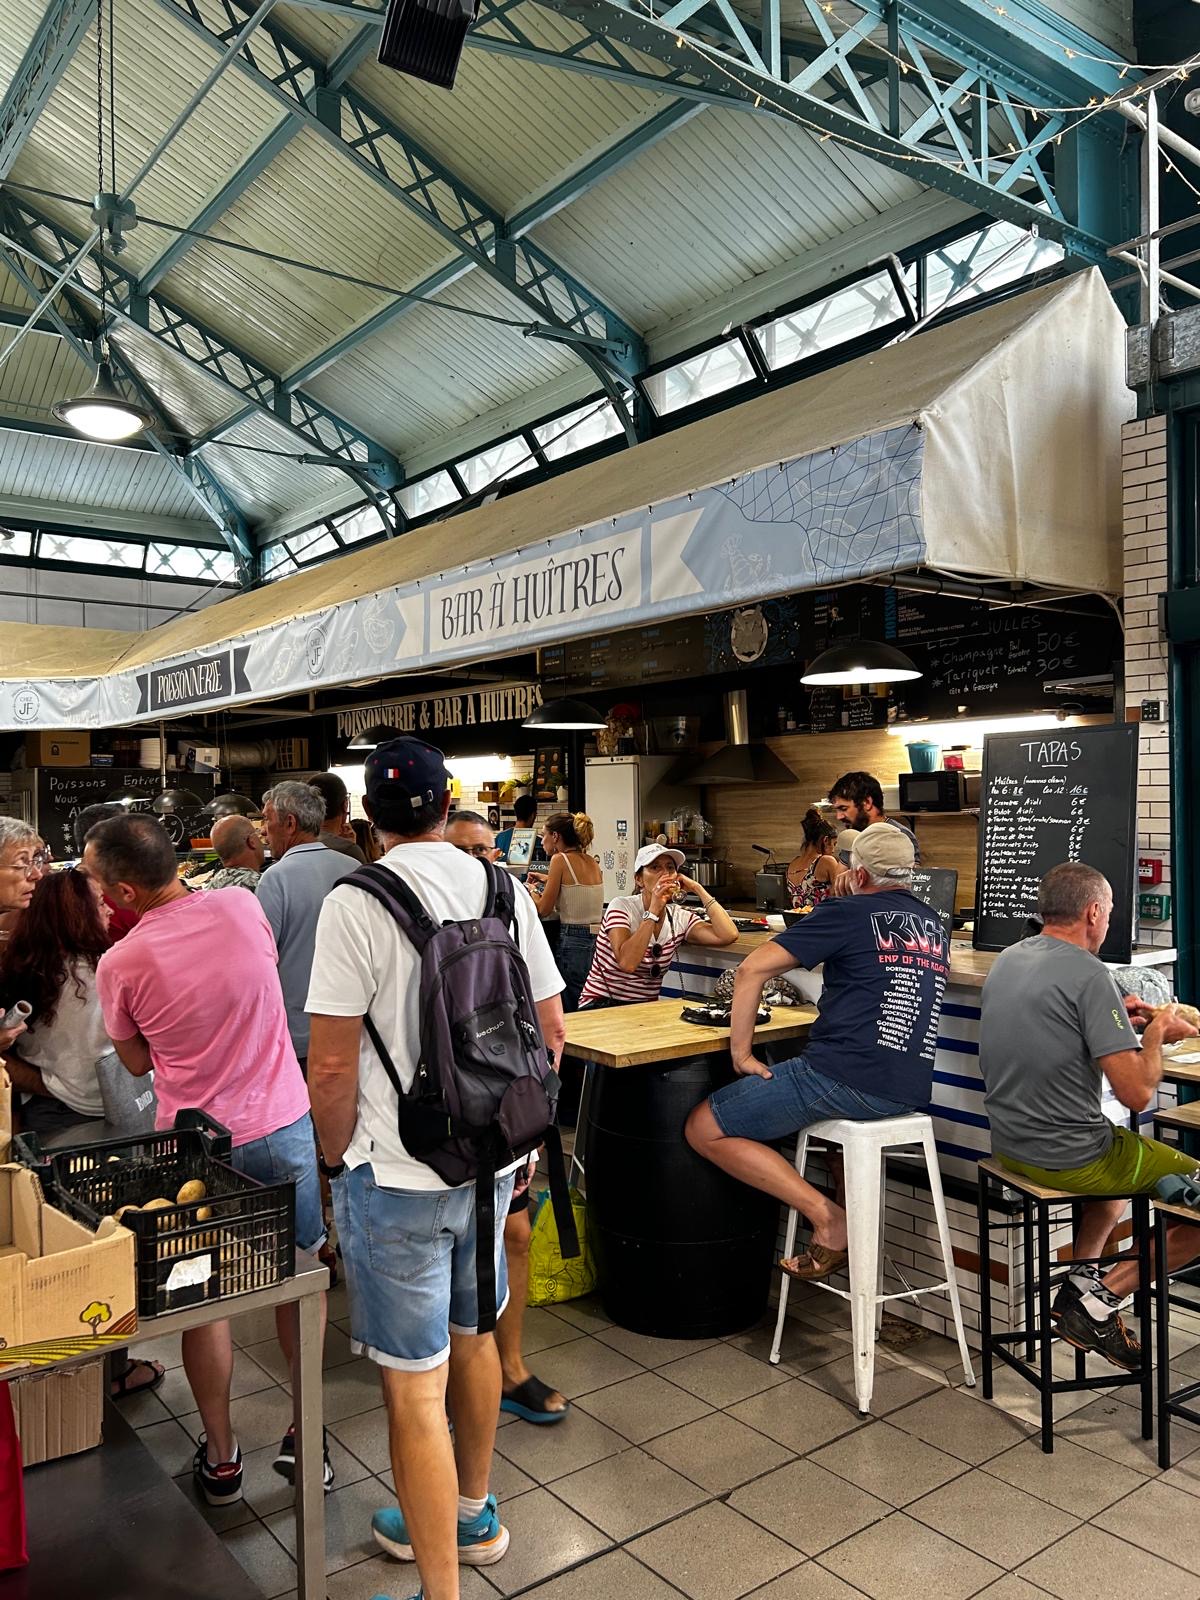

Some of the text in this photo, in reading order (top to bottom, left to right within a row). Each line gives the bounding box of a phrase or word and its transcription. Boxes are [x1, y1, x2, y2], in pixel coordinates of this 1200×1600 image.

[441, 547, 625, 640] BAR À HUÎTRES
[311, 646, 321, 666] JF
[157, 659, 223, 703] POISSONNERIE
[19, 702, 33, 715] JF
[336, 684, 544, 738] POISSONNERIE & BAR A HUITRES
[1020, 741, 1082, 763] TAPAS
[50, 777, 107, 791] Poissons
[124, 774, 168, 786] Entier
[55, 794, 78, 803] Nous
[878, 954, 899, 963] END
[902, 955, 914, 965] OF
[916, 957, 930, 969] THE
